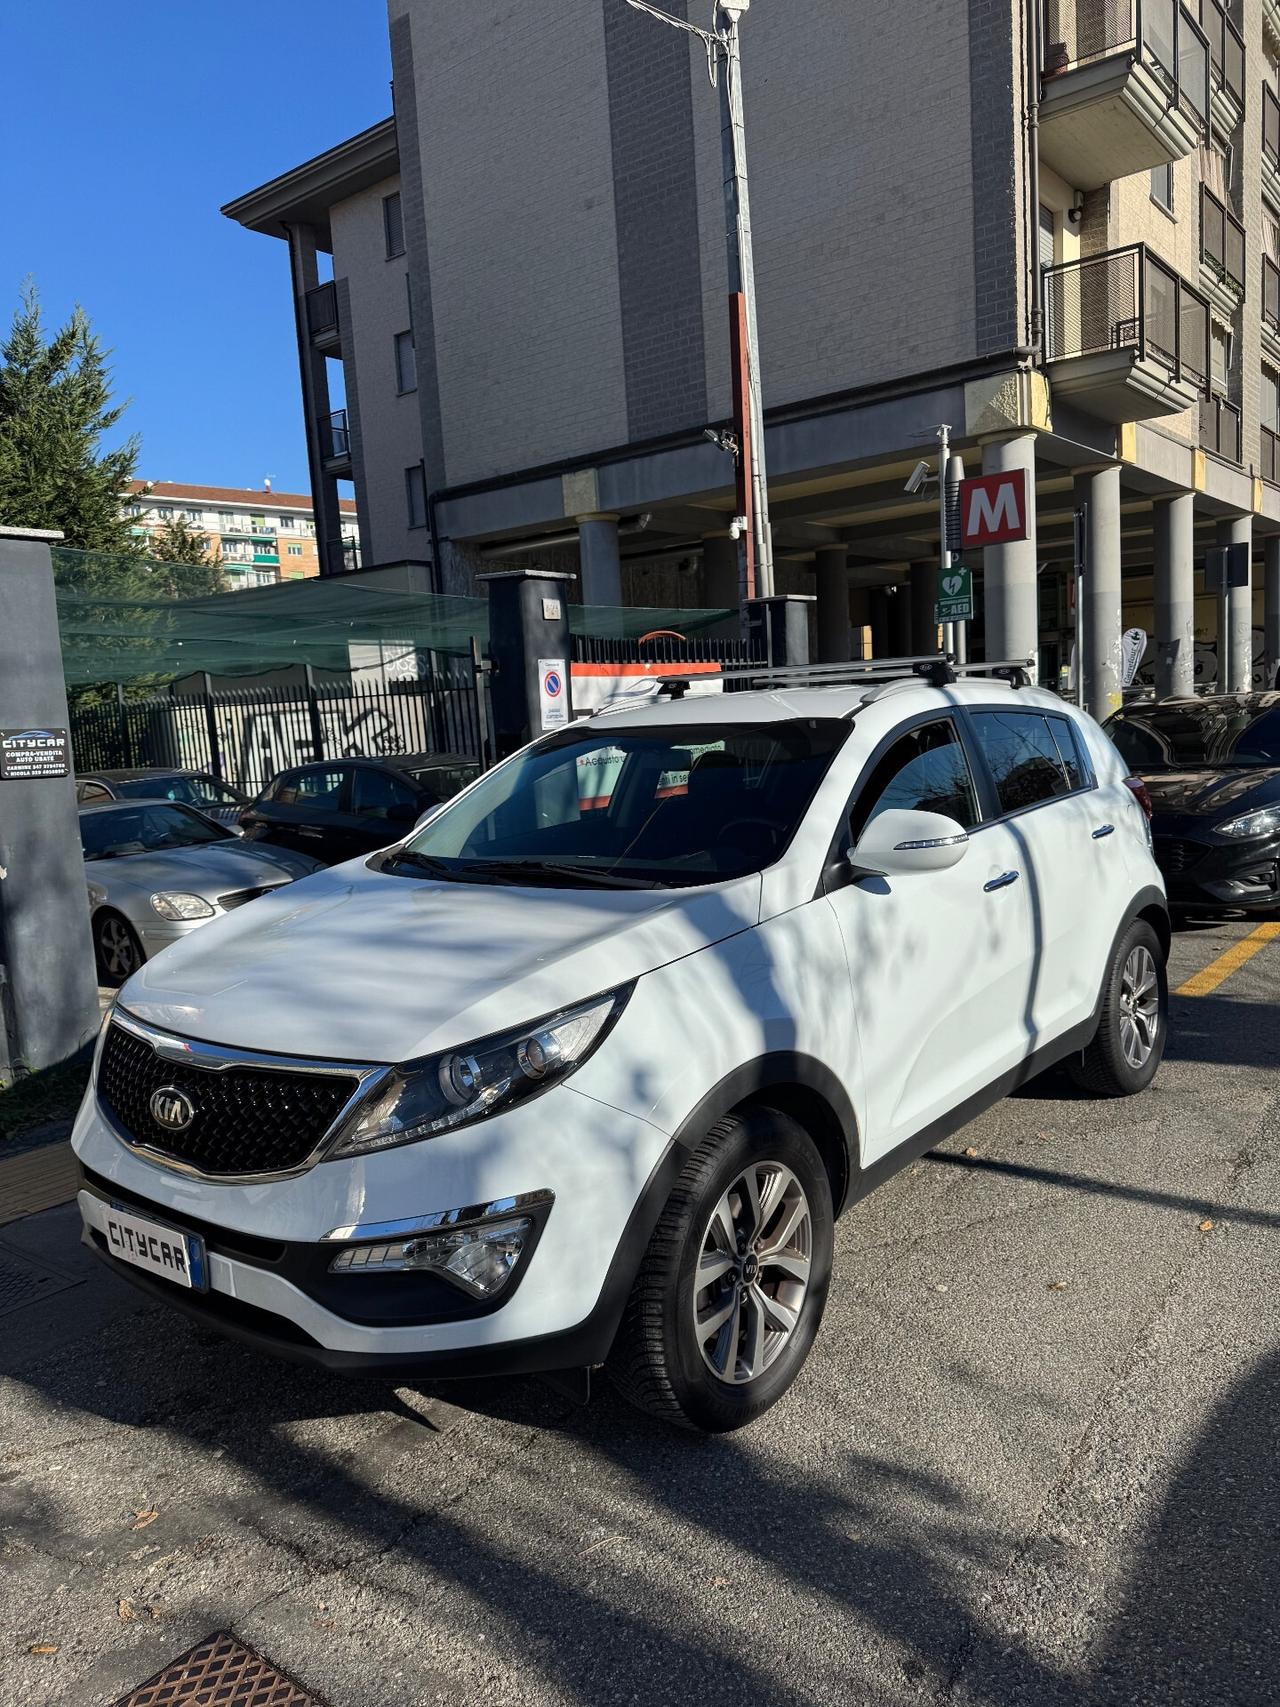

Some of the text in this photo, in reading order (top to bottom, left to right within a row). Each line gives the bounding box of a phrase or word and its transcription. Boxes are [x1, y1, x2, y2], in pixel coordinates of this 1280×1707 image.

[967, 482, 1020, 536] M
[950, 603, 969, 615] AED
[1124, 649, 1136, 684] Carrefour
[2, 738, 65, 748] CITYCAR
[154, 1094, 183, 1125] KIA
[108, 1220, 187, 1274] CITYCAR
